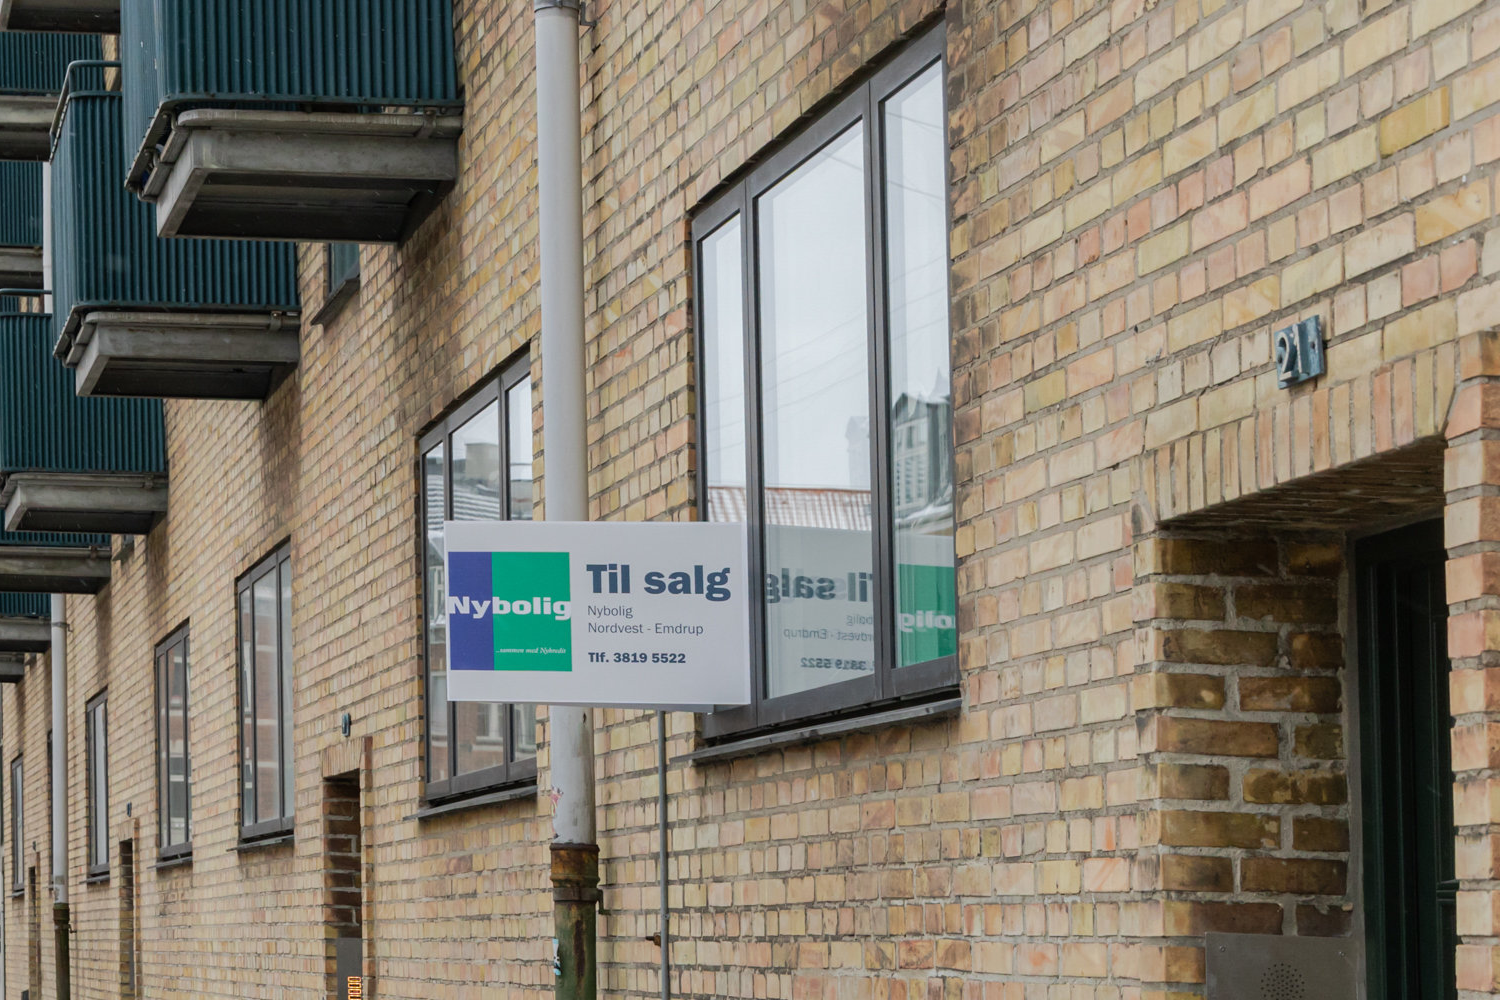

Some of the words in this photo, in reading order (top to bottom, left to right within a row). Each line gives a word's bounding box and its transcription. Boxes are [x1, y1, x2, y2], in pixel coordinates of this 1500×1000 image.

[1275, 323, 1302, 381] 21
[586, 563, 631, 594] Til
[644, 565, 731, 602] salg
[448, 596, 572, 621] Nybolig
[588, 605, 633, 620] Nybolig
[588, 622, 644, 635] Nordvest
[655, 623, 703, 636] Emdrup
[588, 652, 610, 663] Tlf.
[613, 652, 647, 663] 3819
[651, 652, 686, 663] 5522
